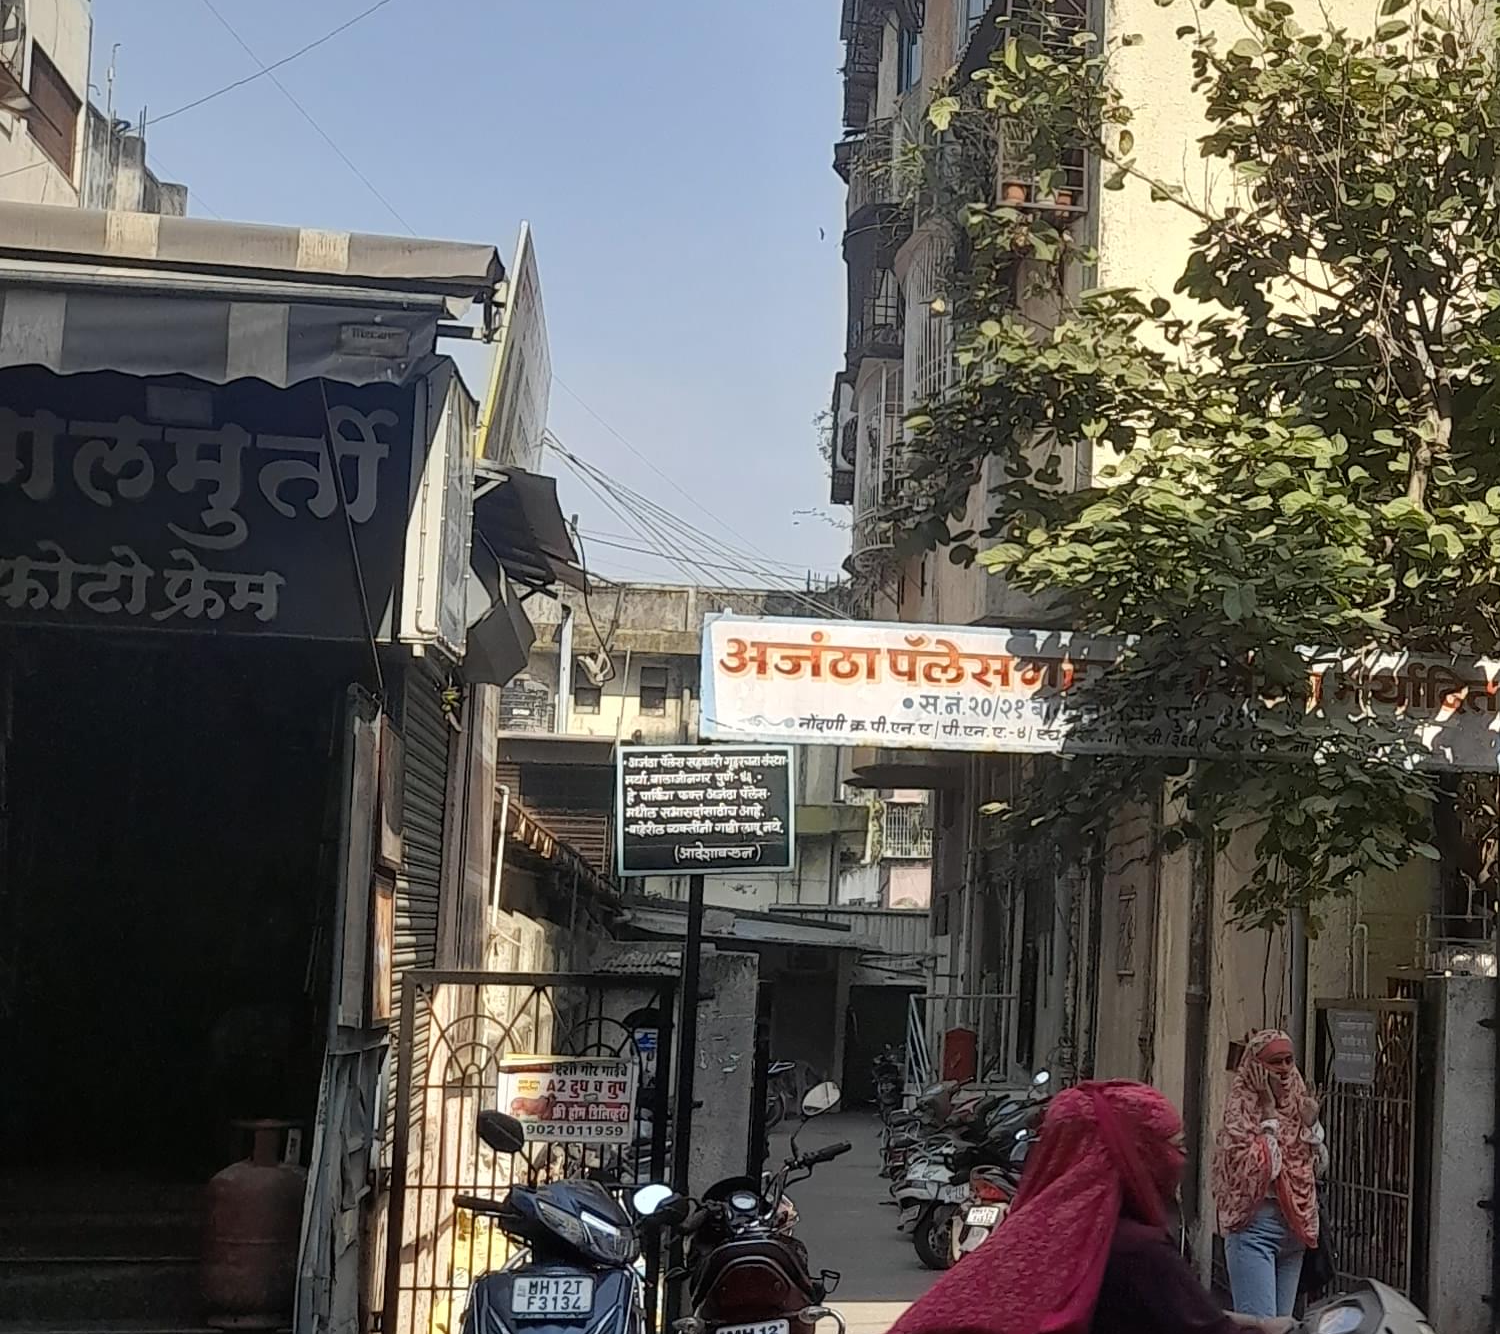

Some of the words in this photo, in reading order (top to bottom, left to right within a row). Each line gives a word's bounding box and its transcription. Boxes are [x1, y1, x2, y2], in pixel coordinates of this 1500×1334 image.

[151, 547, 285, 622] फ्रेम
[719, 630, 882, 682] अजंठा
[887, 634, 1015, 688] पॅलेस
[798, 713, 846, 733] नोंदणी
[546, 1079, 566, 1093] A2
[570, 1079, 590, 1099] दुध
[526, 1124, 624, 1137] 9021011959
